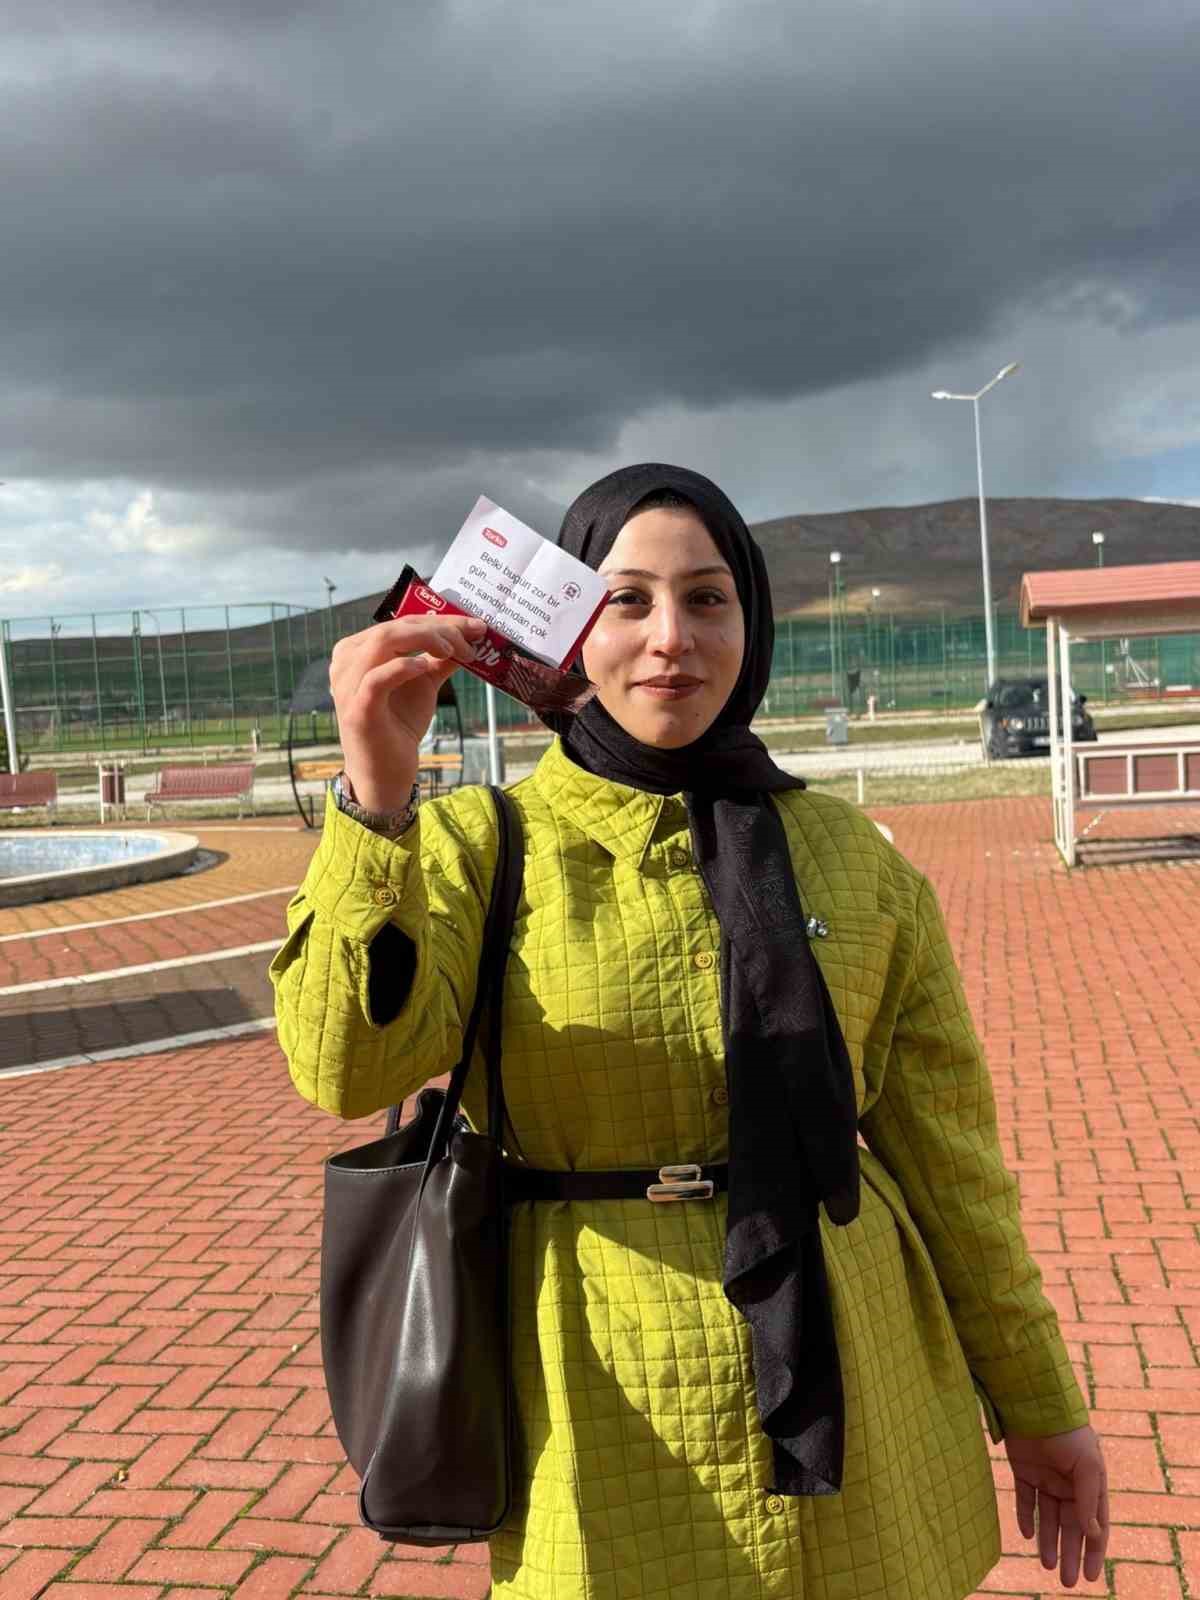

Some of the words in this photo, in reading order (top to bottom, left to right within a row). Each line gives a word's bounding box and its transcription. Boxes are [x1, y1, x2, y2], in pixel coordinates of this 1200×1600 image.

[480, 552, 503, 570] Belki
[503, 566, 531, 590] bugün
[531, 586, 546, 599] zor
[547, 594, 560, 609] bir
[419, 587, 442, 607] Torku
[497, 583, 518, 600] ama
[458, 577, 475, 591] sen
[475, 589, 530, 626] sandığından
[530, 624, 549, 639] çok
[462, 597, 484, 616] daha
